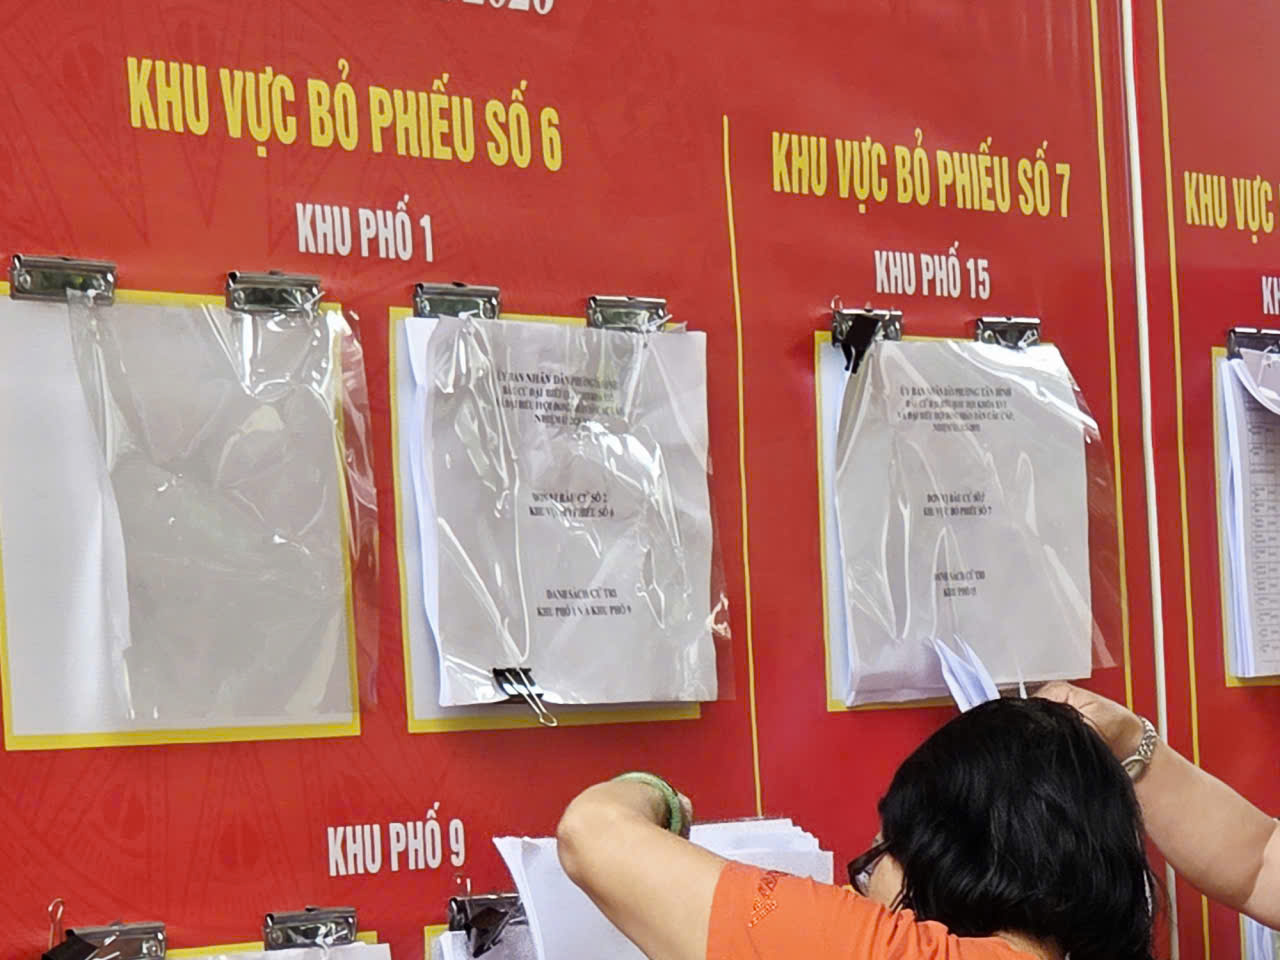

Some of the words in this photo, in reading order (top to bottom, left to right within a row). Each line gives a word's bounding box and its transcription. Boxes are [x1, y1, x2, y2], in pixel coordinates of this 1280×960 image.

[127, 57, 209, 135] KHU
[220, 66, 296, 157] VỰC
[307, 59, 358, 151] BỎ
[369, 73, 474, 162] PHIẾU
[485, 80, 531, 168] SỐ
[540, 107, 562, 171] 6
[772, 132, 827, 196] KHU
[835, 136, 888, 213] VỰC
[894, 128, 930, 205] BỎ
[936, 137, 1010, 213] PHIẾU
[1018, 141, 1050, 216] SỐ
[1056, 163, 1070, 217] 7
[1184, 171, 1227, 228] KHU
[1232, 175, 1274, 243] VỰC
[296, 203, 351, 256] KHU
[358, 194, 412, 260] PHỐ
[420, 215, 433, 262] 1
[874, 250, 916, 295] KHU
[920, 241, 961, 298] PHỐ
[966, 258, 990, 299] 15
[328, 824, 381, 876] KHU
[389, 802, 442, 871] PHỐ
[449, 819, 465, 866] 9
